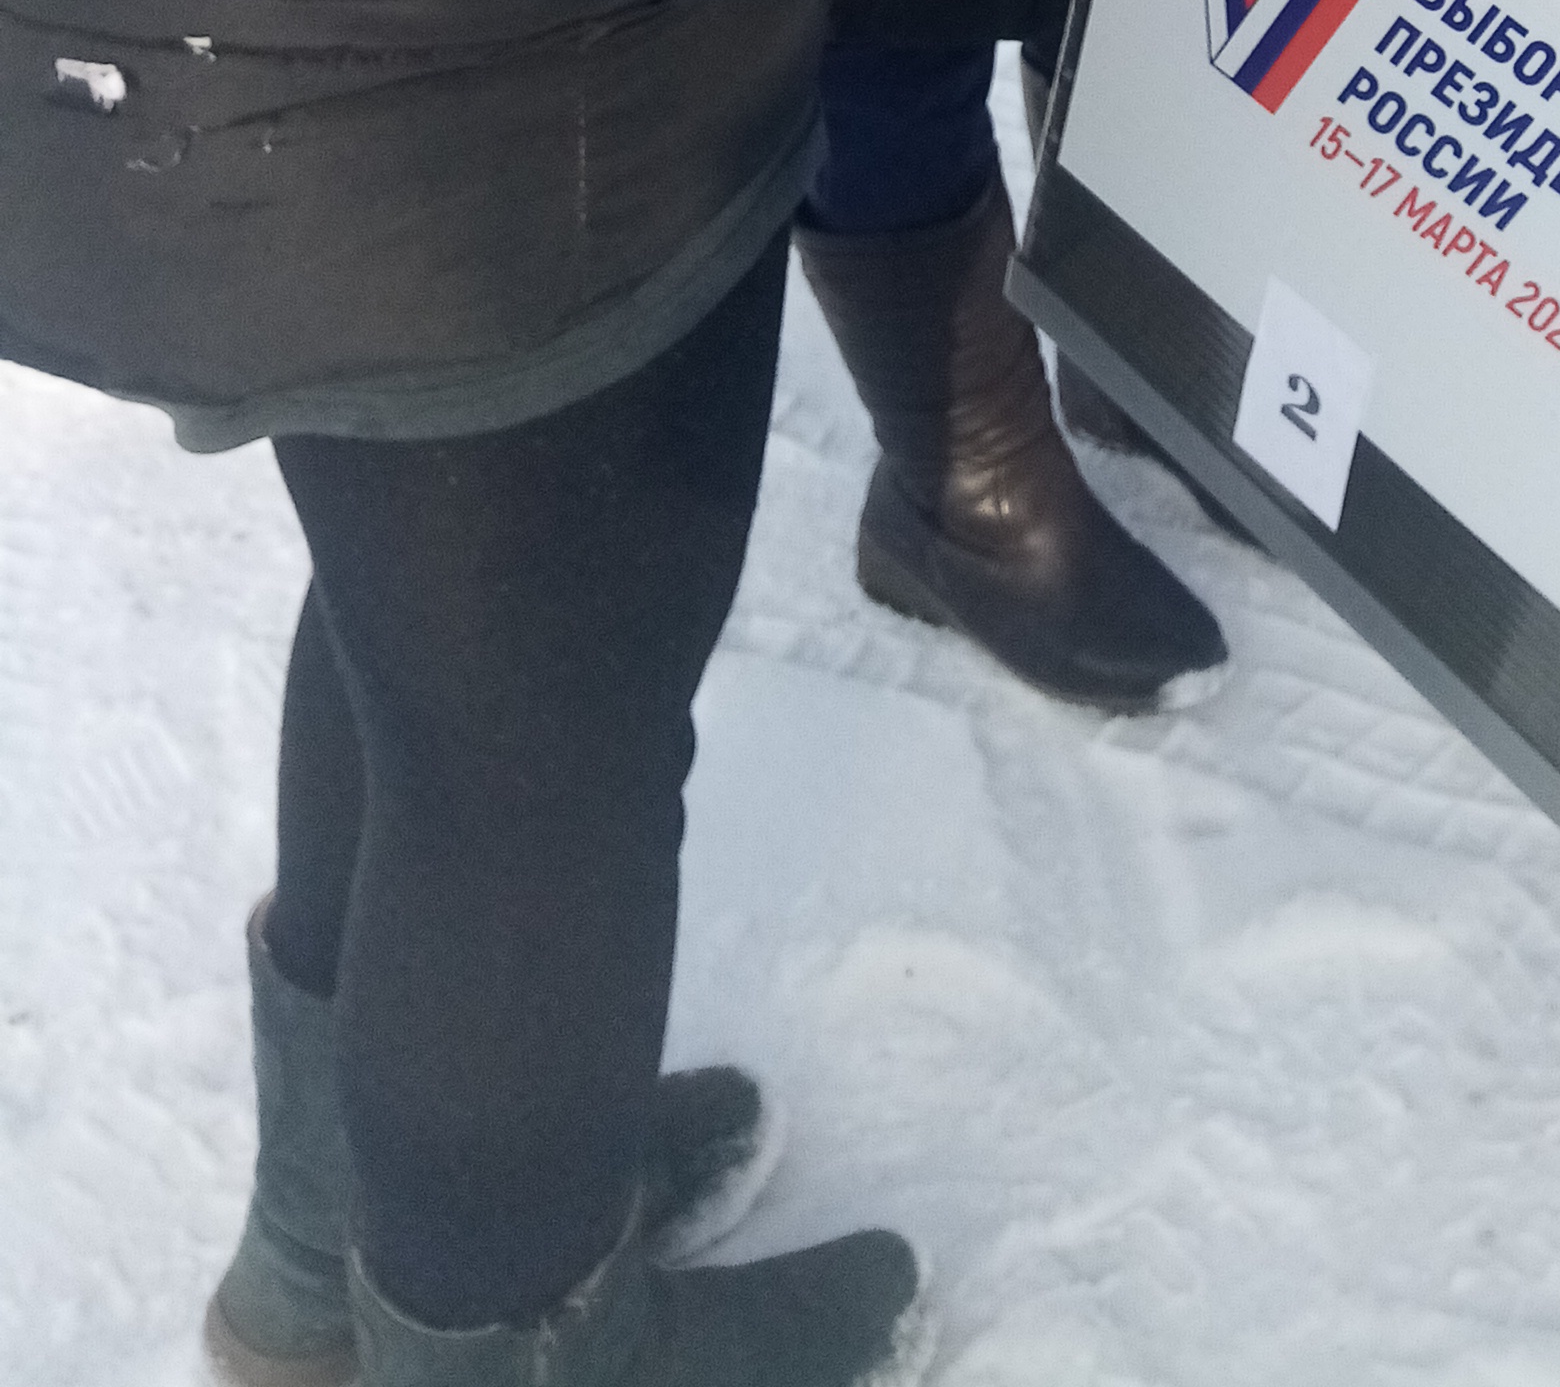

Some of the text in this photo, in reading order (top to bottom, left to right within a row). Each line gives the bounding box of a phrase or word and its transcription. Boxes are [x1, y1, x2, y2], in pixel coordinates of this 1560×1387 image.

[1337, 65, 1530, 232] РОССИИ
[1392, 185, 1512, 297] МАРТА
[1279, 373, 1321, 442] 2
